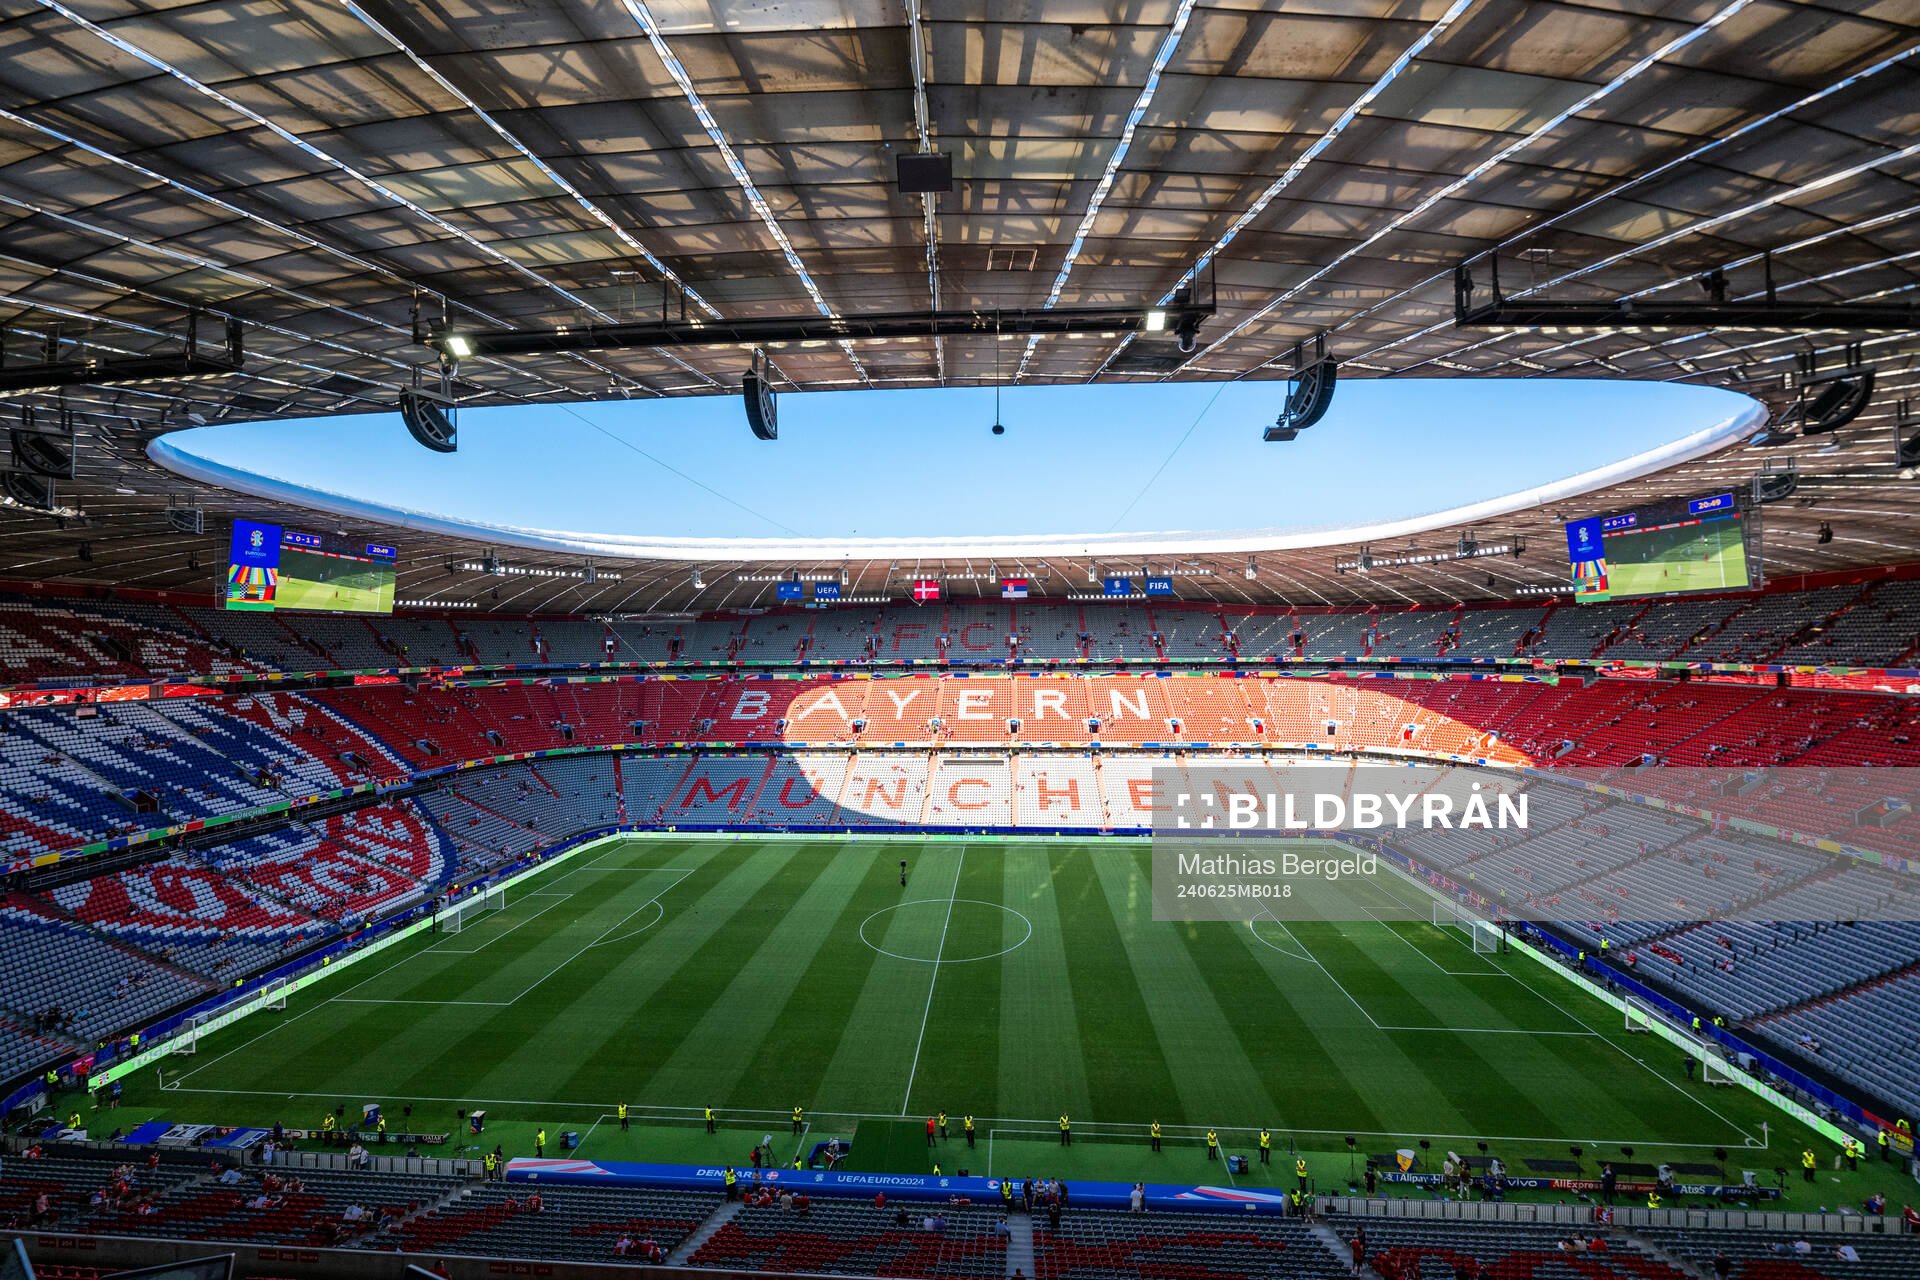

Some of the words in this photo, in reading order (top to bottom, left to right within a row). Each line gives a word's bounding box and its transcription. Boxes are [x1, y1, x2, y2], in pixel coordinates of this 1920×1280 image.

[1697, 499, 1721, 510] 20:49
[372, 546, 389, 554] 20:49
[1149, 582, 1169, 590] FIFA
[731, 689, 1151, 721] BAYERN
[680, 771, 1264, 811] MÜNCHEN
[1399, 1173, 1429, 1184] Alipay
[1507, 1178, 1538, 1187] vivo
